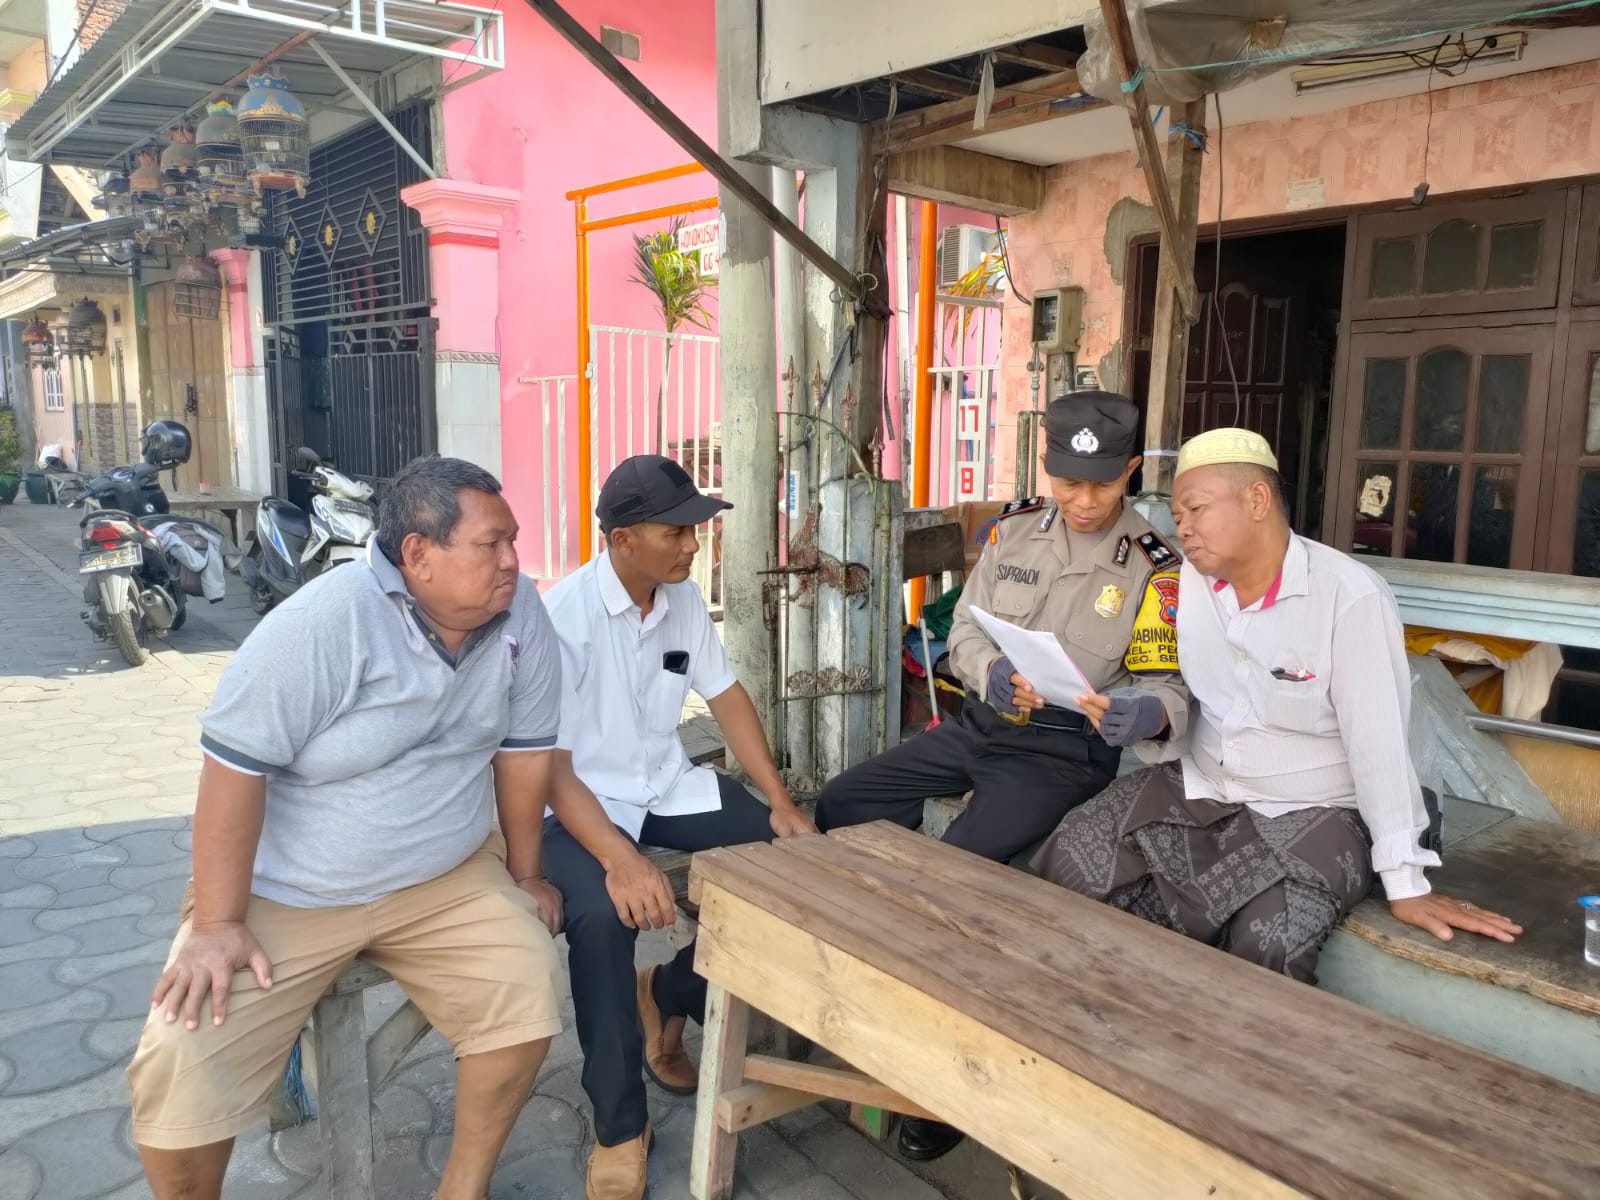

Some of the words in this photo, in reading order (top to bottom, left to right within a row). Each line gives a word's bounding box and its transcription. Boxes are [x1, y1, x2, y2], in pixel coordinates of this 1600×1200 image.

[960, 405, 979, 432] 17
[961, 467, 973, 494] 8
[997, 564, 1040, 586] SUPRIADI
